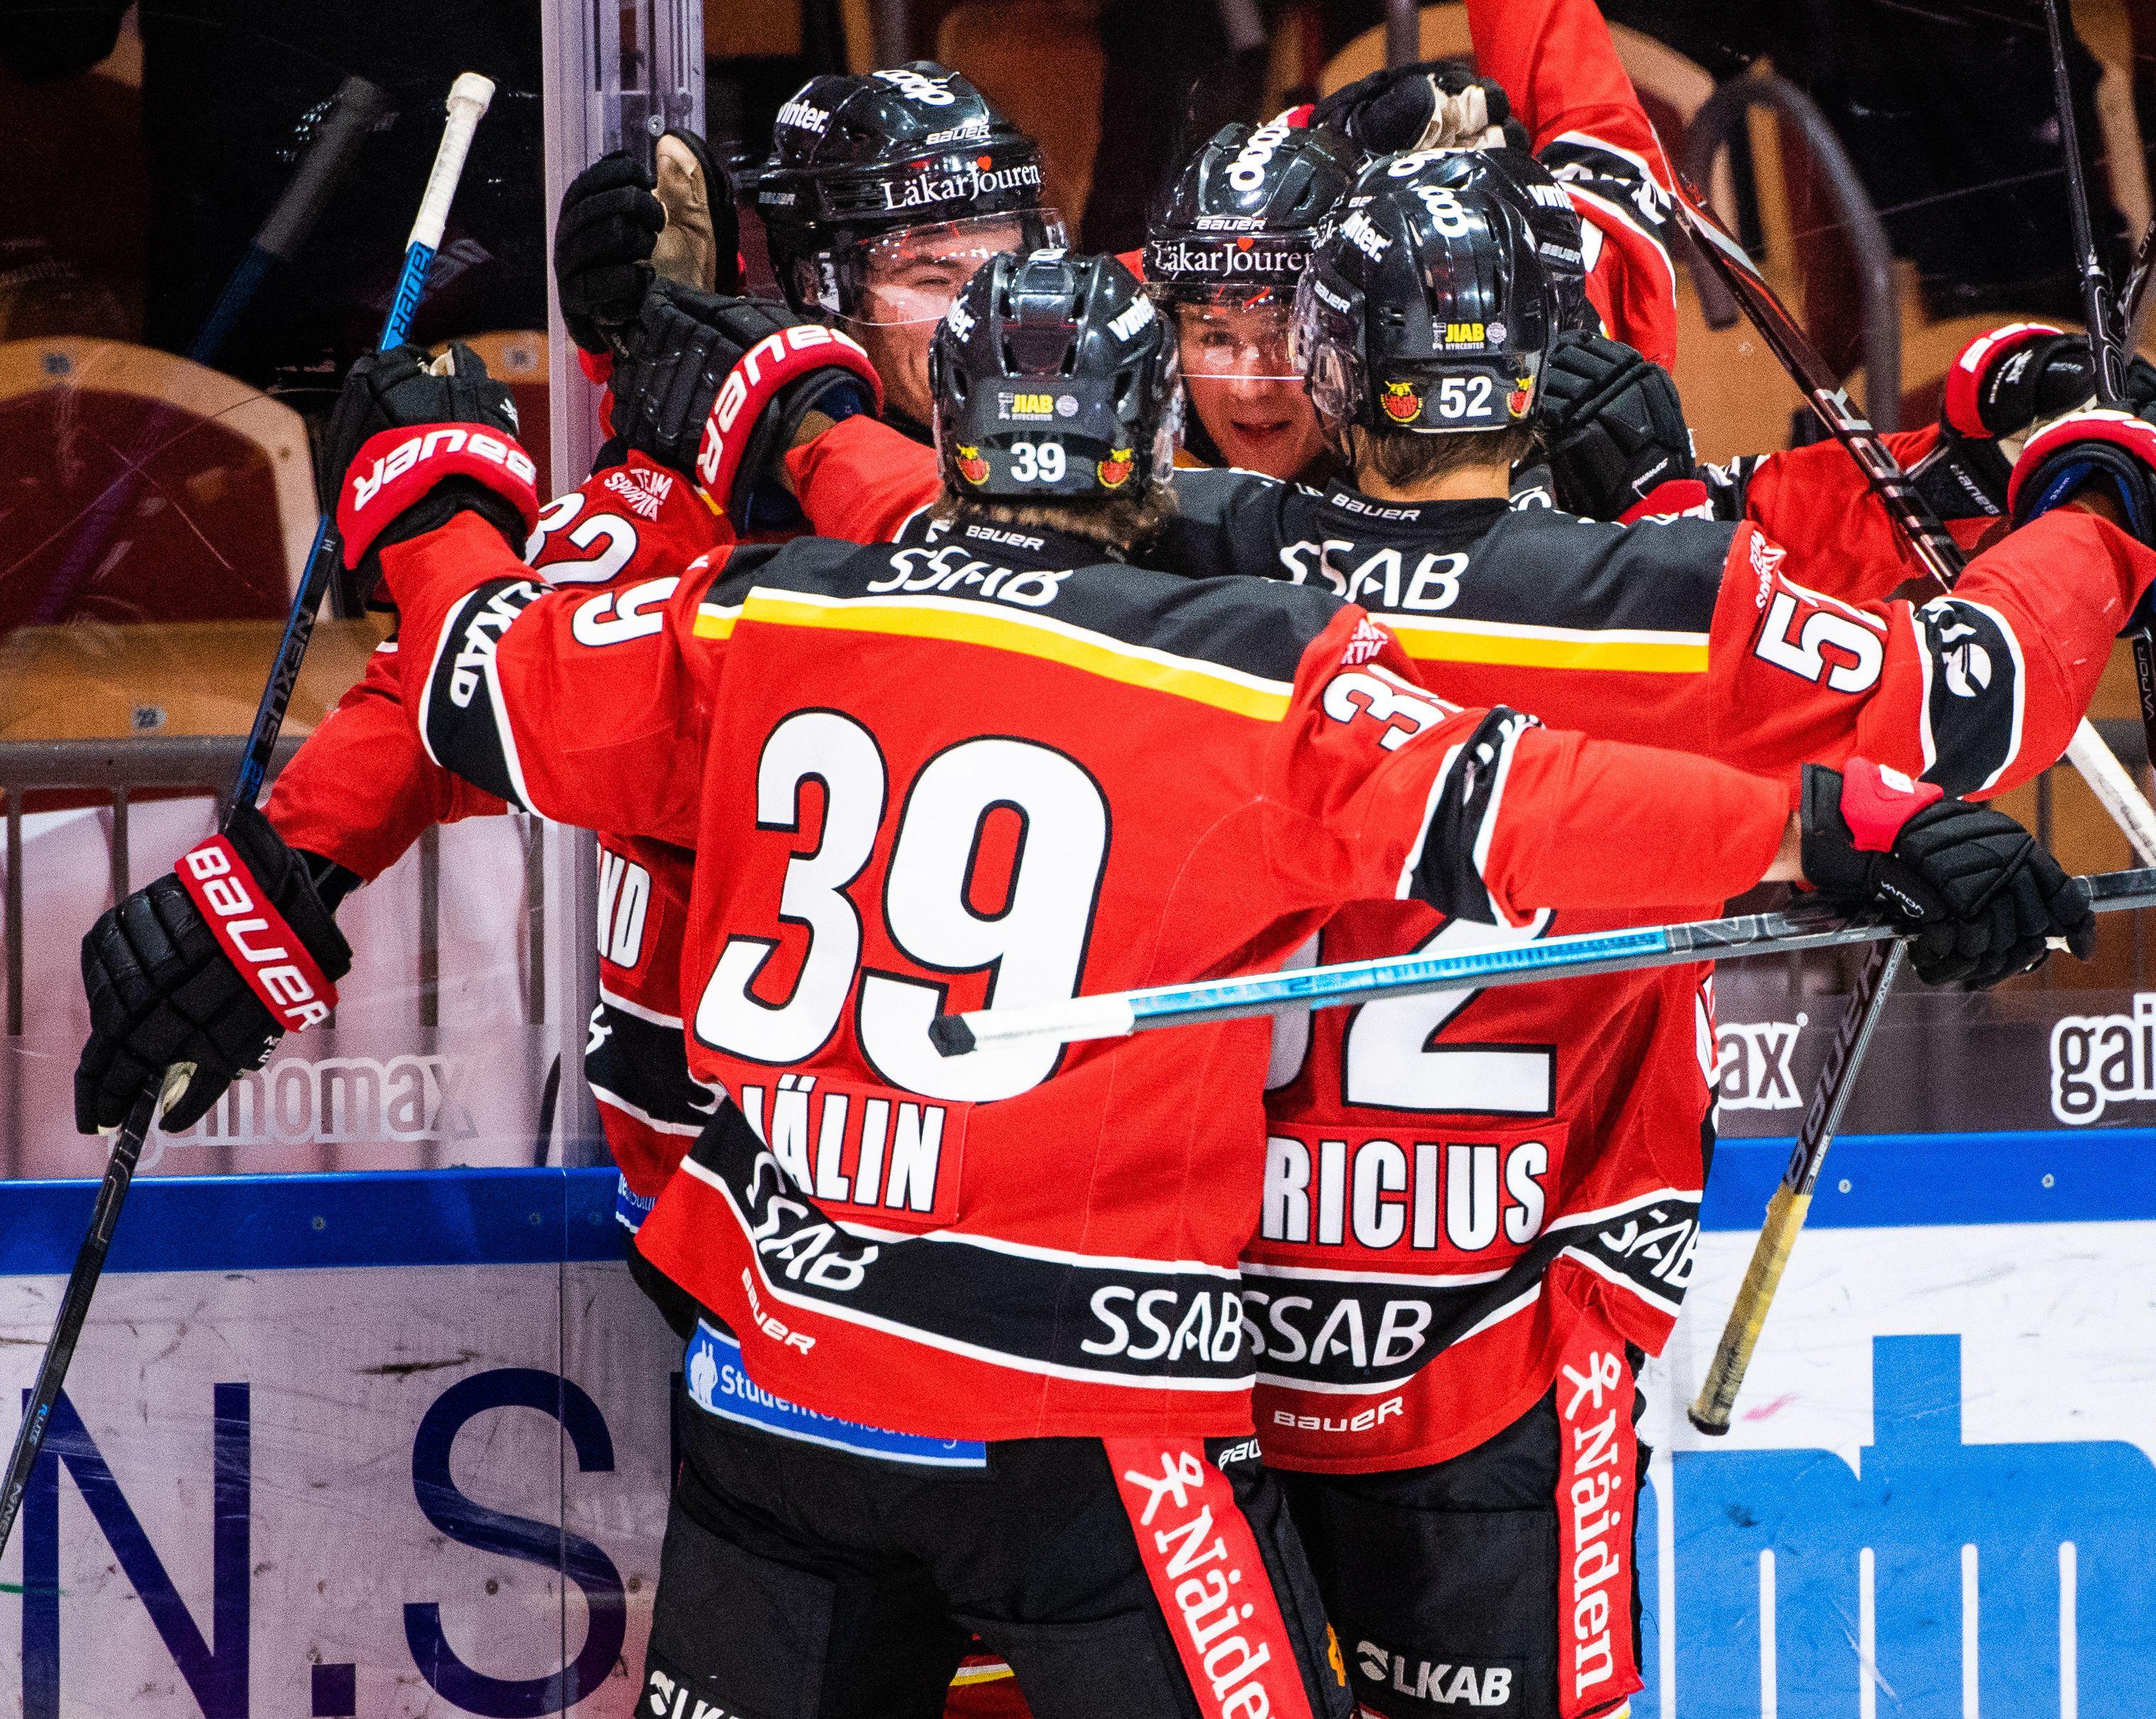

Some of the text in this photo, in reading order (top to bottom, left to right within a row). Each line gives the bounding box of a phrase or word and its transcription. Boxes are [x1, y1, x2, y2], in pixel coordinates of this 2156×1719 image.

[882, 163, 1042, 210] LäkarJouren
[1444, 323, 1485, 343] JIAB
[1011, 394, 1054, 413] JIAB
[1439, 376, 1492, 418] 52
[353, 429, 537, 512] BAUER
[1010, 442, 1066, 483] 39
[1332, 494, 1422, 522] BAUER
[966, 524, 1045, 551] BAUER
[697, 709, 1110, 1102] 39
[186, 845, 332, 1032] BAUER
[741, 1267, 816, 1356] BAUER
[1080, 1285, 1245, 1363] SSAB
[1274, 1396, 1403, 1433] BAUER
[1393, 1655, 1512, 1706] LKAB
